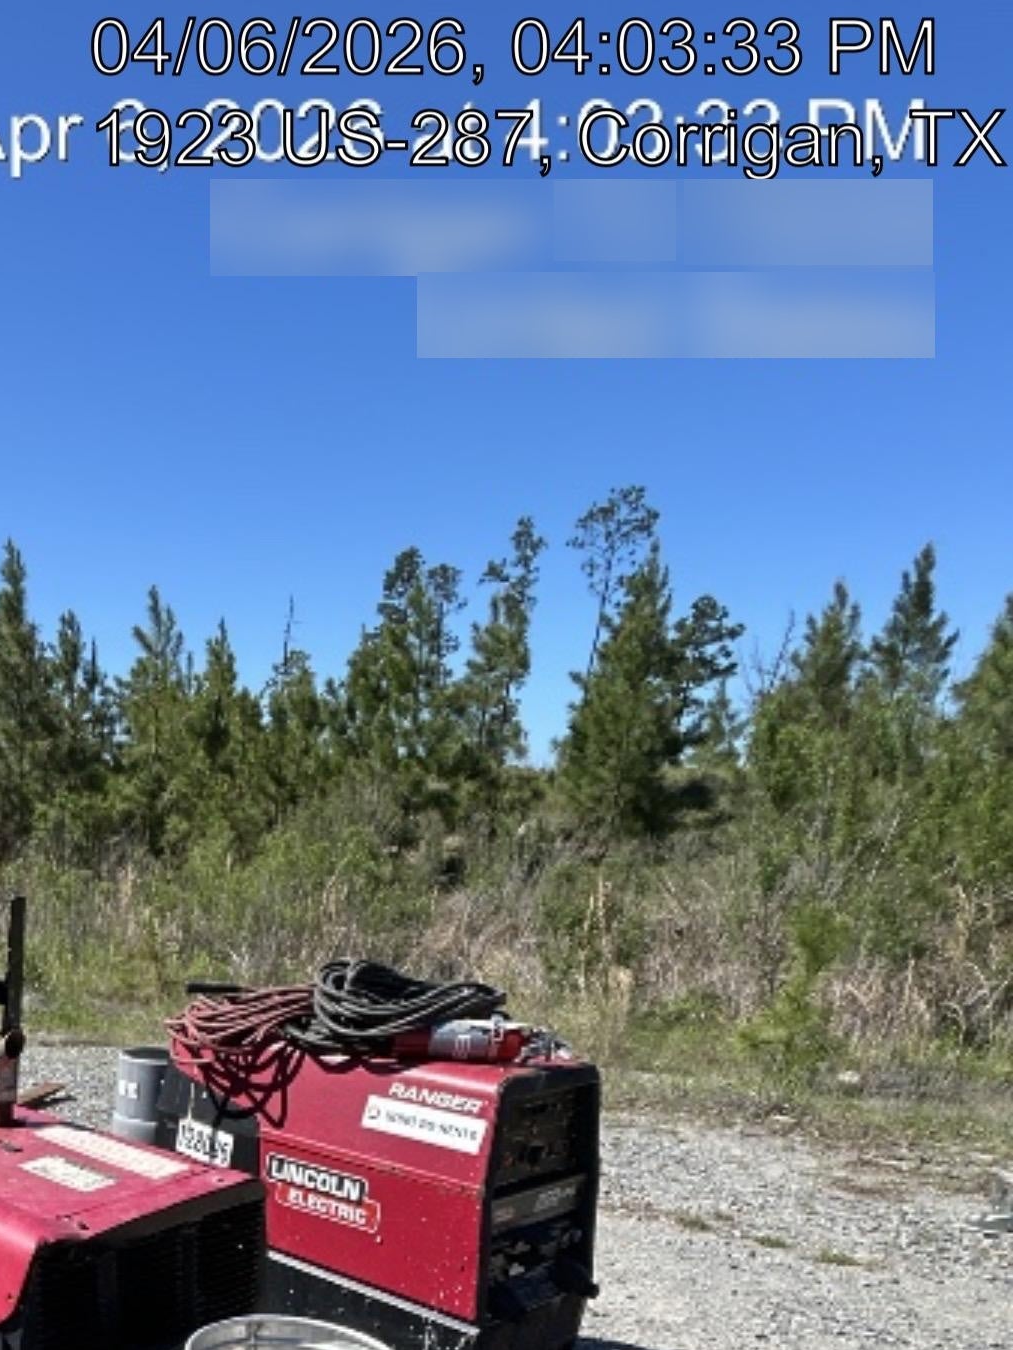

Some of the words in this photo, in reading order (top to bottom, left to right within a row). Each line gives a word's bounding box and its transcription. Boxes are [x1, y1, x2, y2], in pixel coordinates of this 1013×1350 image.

[388, 1082, 482, 1114] RANGER
[271, 1158, 361, 1201] LINCOLN
[288, 1186, 367, 1225] ELECTRIC
